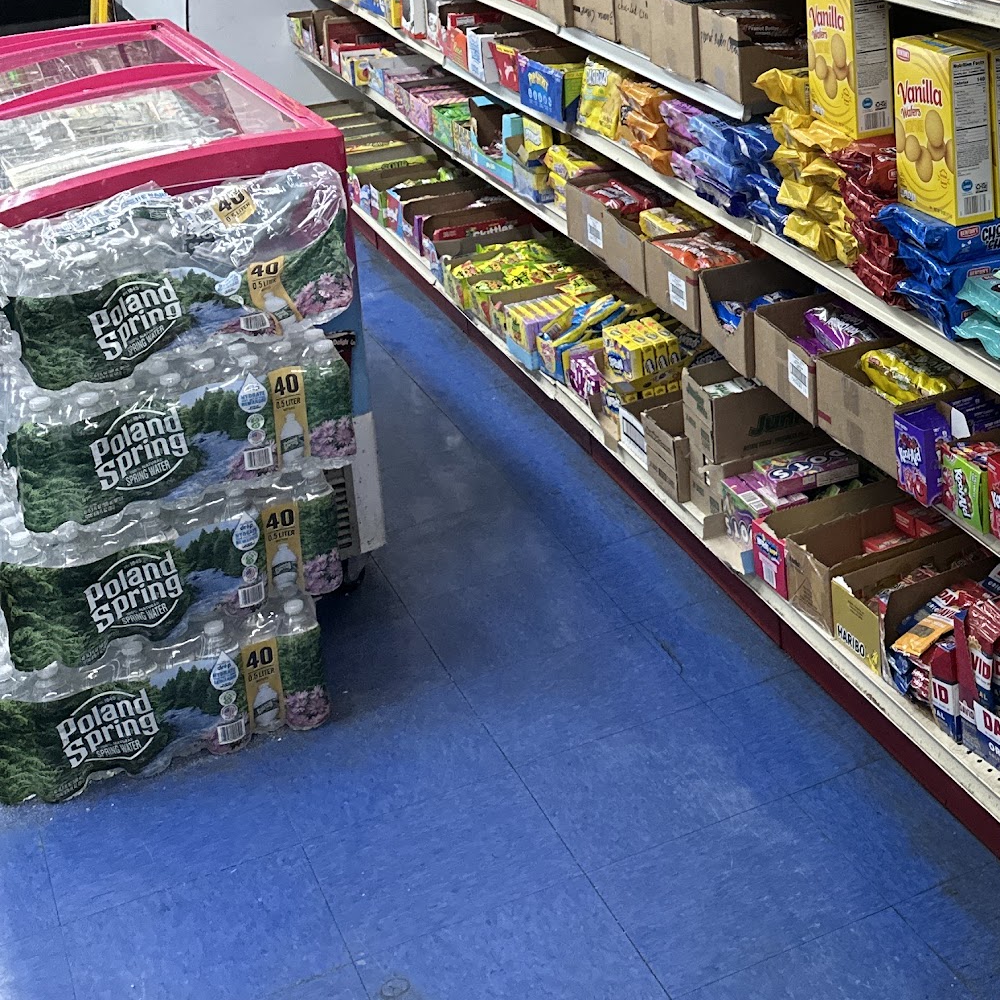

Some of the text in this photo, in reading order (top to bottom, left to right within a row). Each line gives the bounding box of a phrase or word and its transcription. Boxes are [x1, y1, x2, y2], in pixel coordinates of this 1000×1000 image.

[809, 7, 845, 32] Vanilla
[811, 27, 828, 40] Wafers
[897, 78, 943, 107] Vanilla
[900, 107, 922, 119] Wafers
[250, 262, 279, 277] 40
[88, 278, 179, 339] Poland
[96, 298, 182, 361] Spring
[127, 325, 165, 355] SPRING WATER
[274, 374, 298, 395] 40
[286, 397, 301, 407] LITER
[90, 407, 183, 467] Poland
[97, 431, 190, 490] Spring
[126, 460, 171, 486] SPRING WATER
[954, 468, 971, 519] Kool-Aid
[266, 509, 294, 529] 40
[278, 530, 295, 539] LITER
[83, 551, 178, 611] Poland
[90, 573, 183, 633] Spring
[121, 603, 168, 625] SPRING WATER
[837, 623, 866, 659] HARIBO
[246, 646, 273, 669] 40
[259, 668, 274, 679] LITER
[56, 689, 152, 746] Poland
[62, 712, 159, 768] Spring
[96, 739, 141, 758] SPRING WATER
